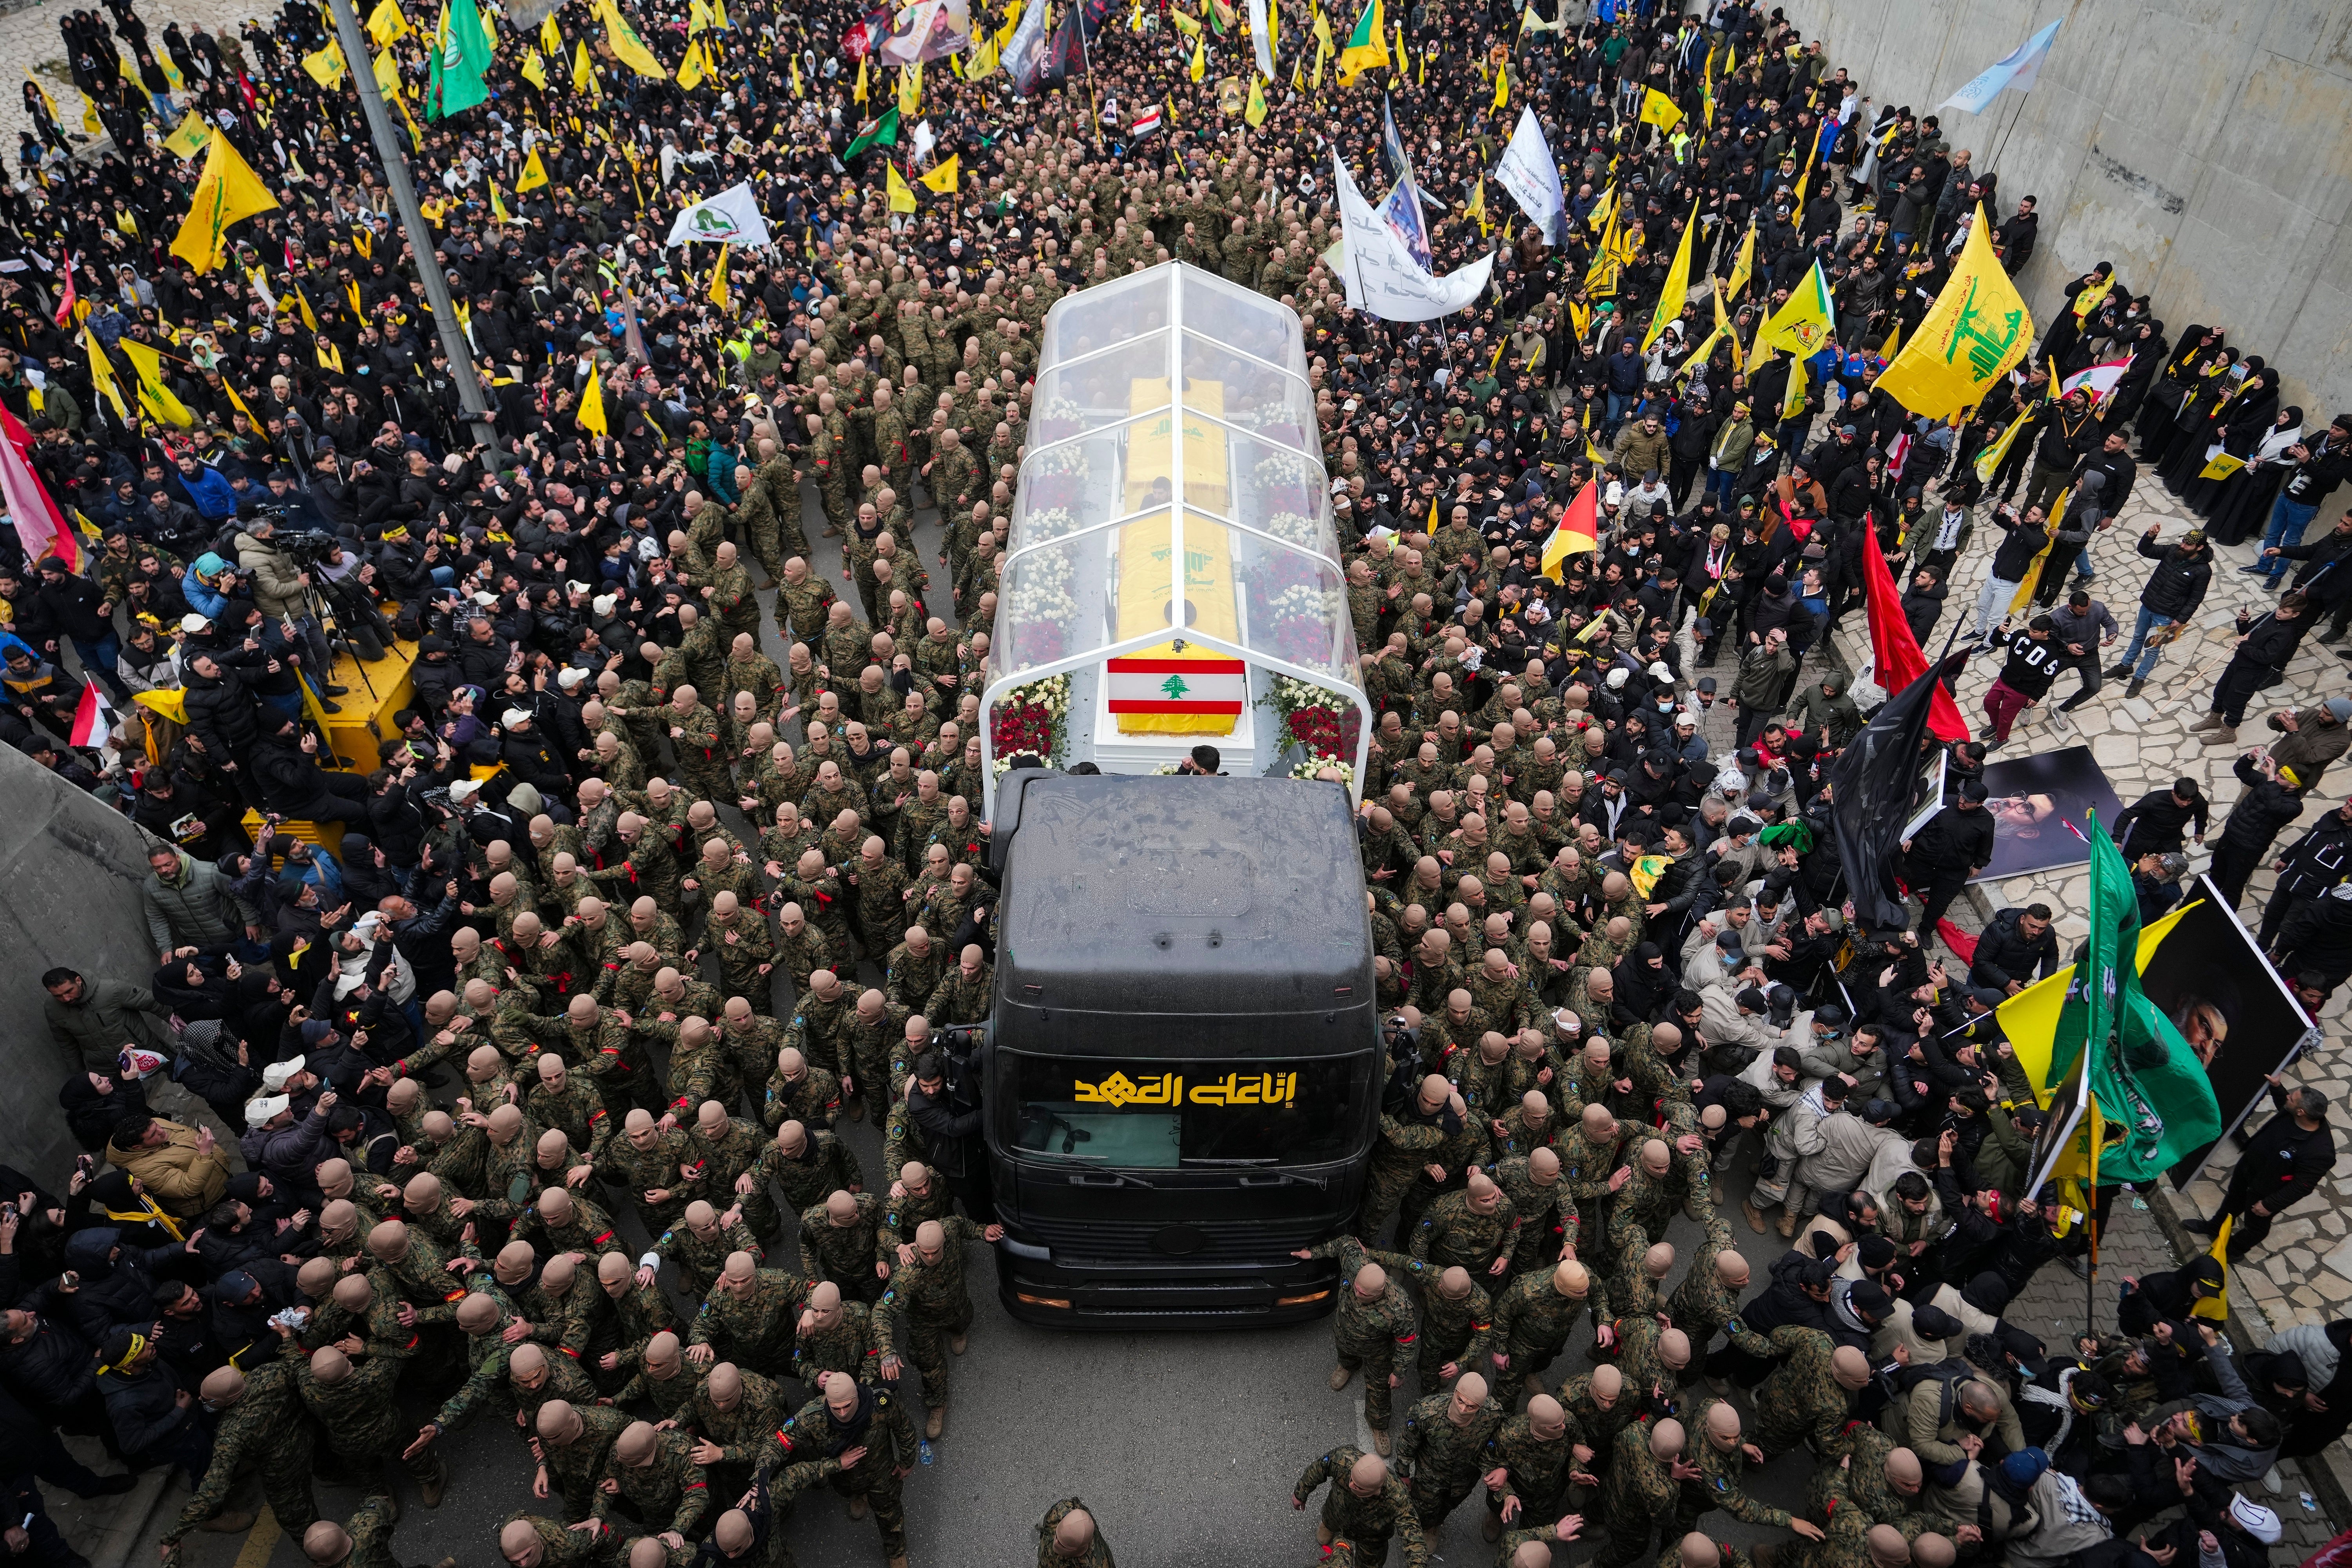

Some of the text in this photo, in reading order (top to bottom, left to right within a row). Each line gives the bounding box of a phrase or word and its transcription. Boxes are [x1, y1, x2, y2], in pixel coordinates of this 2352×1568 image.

[1526, 192, 1542, 208] محمد
[1958, 289, 1967, 305] حزب
[1938, 329, 1950, 352] الغالبون
[1075, 1070, 1183, 1108] العهد
[1189, 1072, 1261, 1107] على
